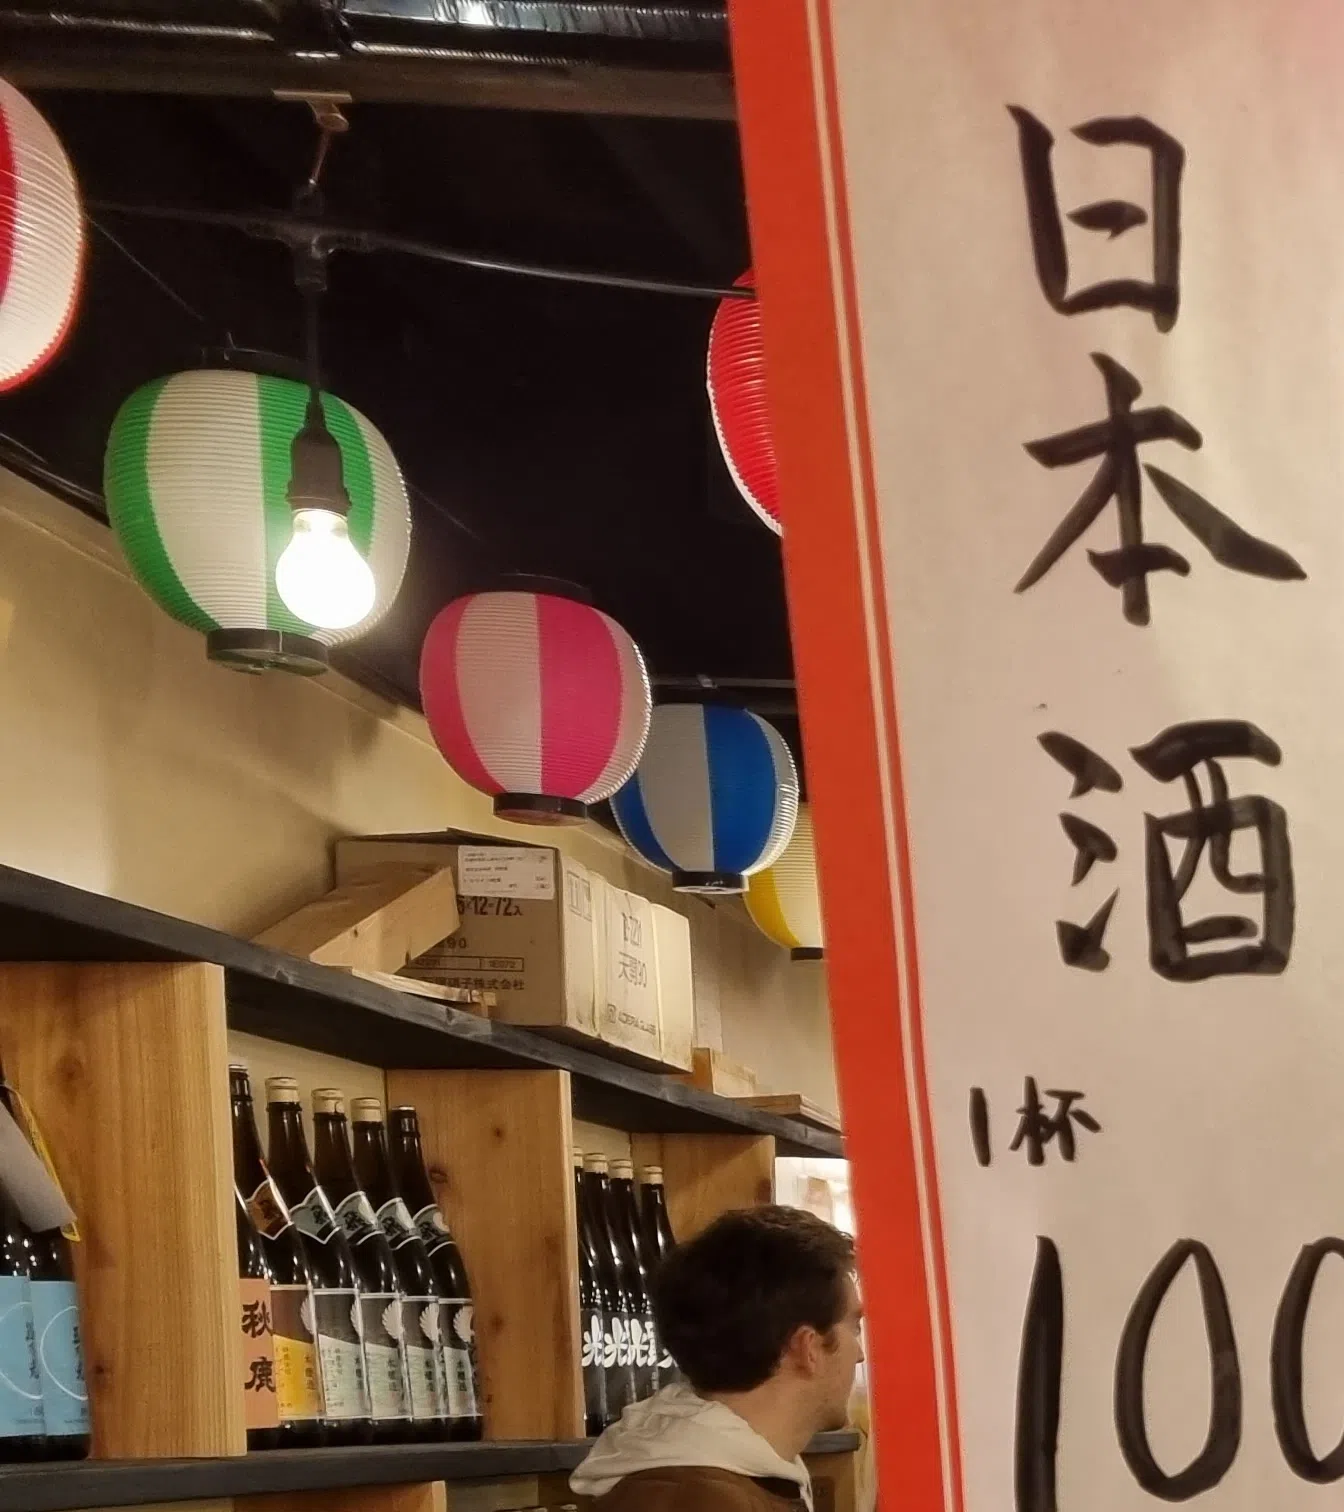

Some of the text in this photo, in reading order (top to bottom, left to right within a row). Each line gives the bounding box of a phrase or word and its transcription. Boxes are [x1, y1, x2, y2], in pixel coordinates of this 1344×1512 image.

[1007, 103, 1308, 982] 日本酒
[968, 1075, 1101, 1168] 1杯
[241, 1300, 276, 1392] 秋鹿
